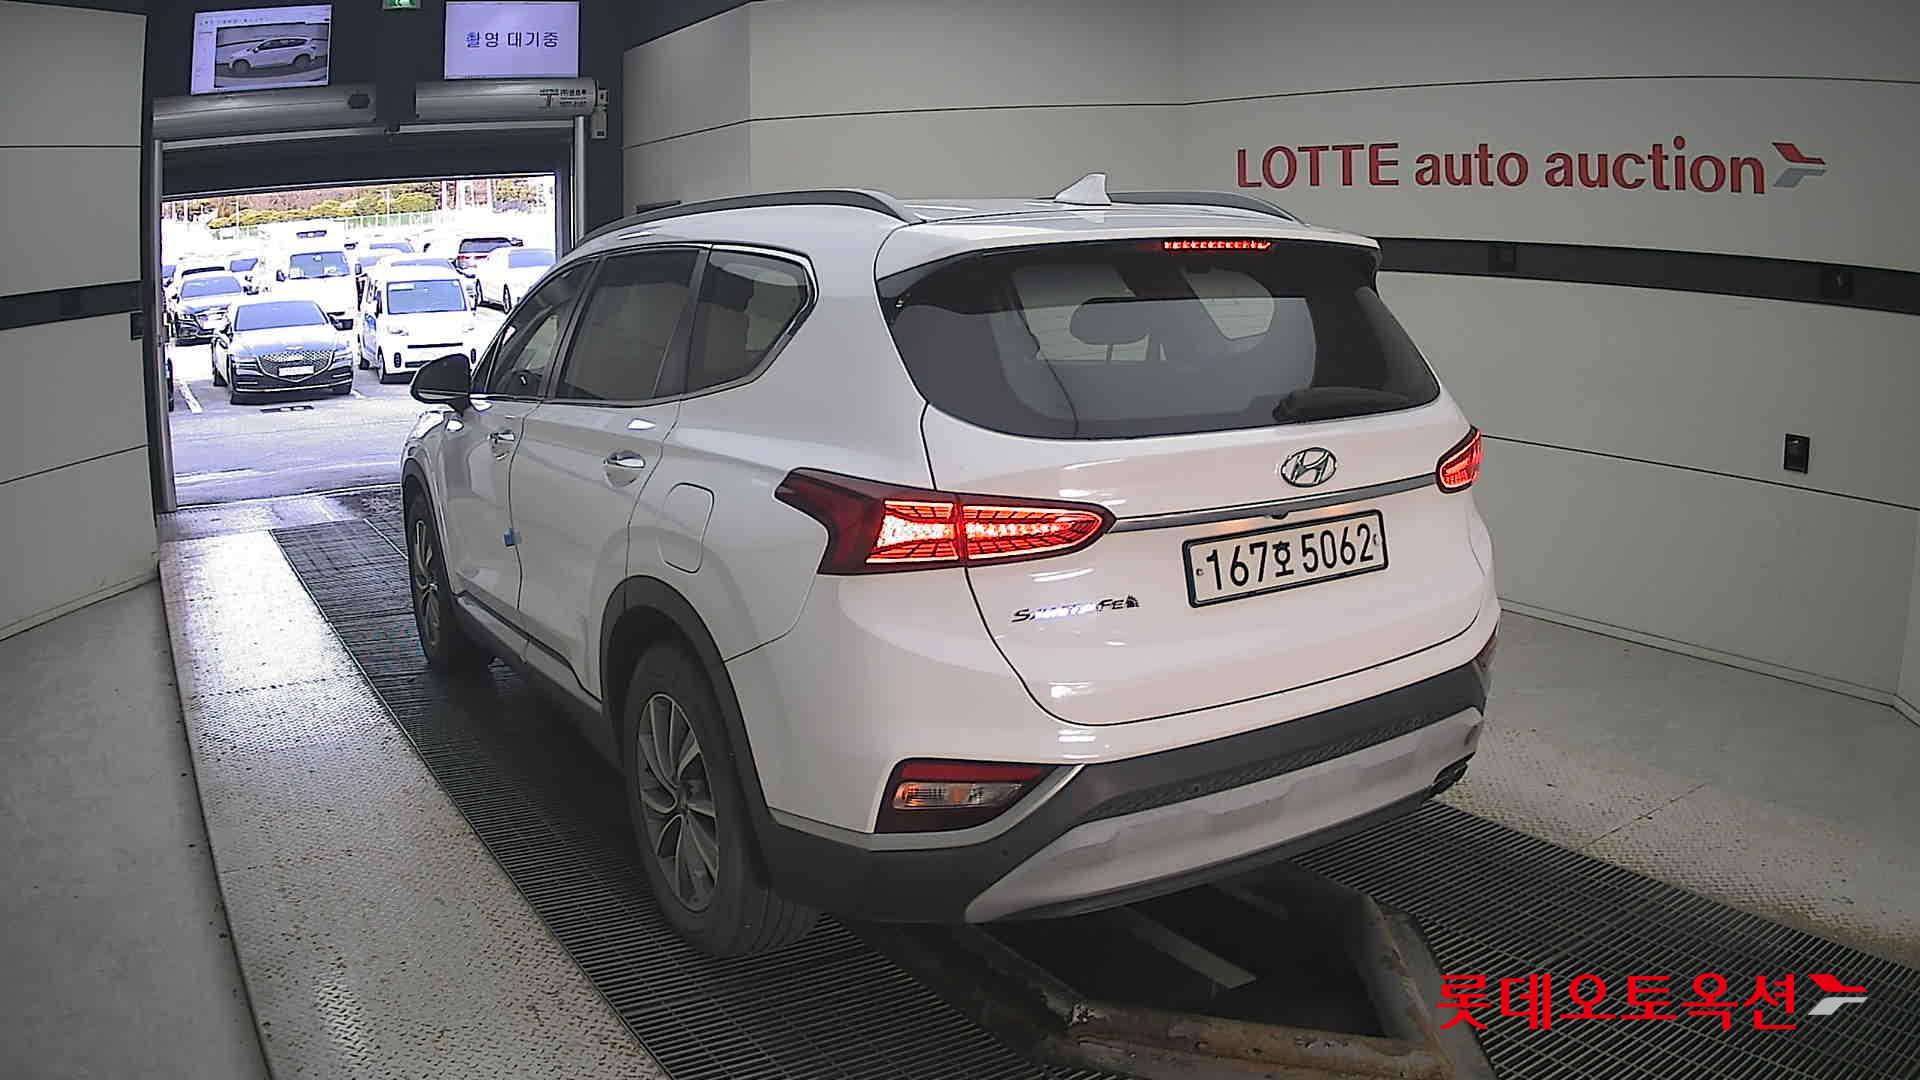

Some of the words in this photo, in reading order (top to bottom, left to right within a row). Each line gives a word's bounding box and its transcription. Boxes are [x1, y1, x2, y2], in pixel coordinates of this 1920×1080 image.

[507, 31, 559, 48] 대기중
[1236, 142, 1399, 188] LOTTE
[1415, 142, 1529, 187] auto
[1545, 136, 1766, 194] auction
